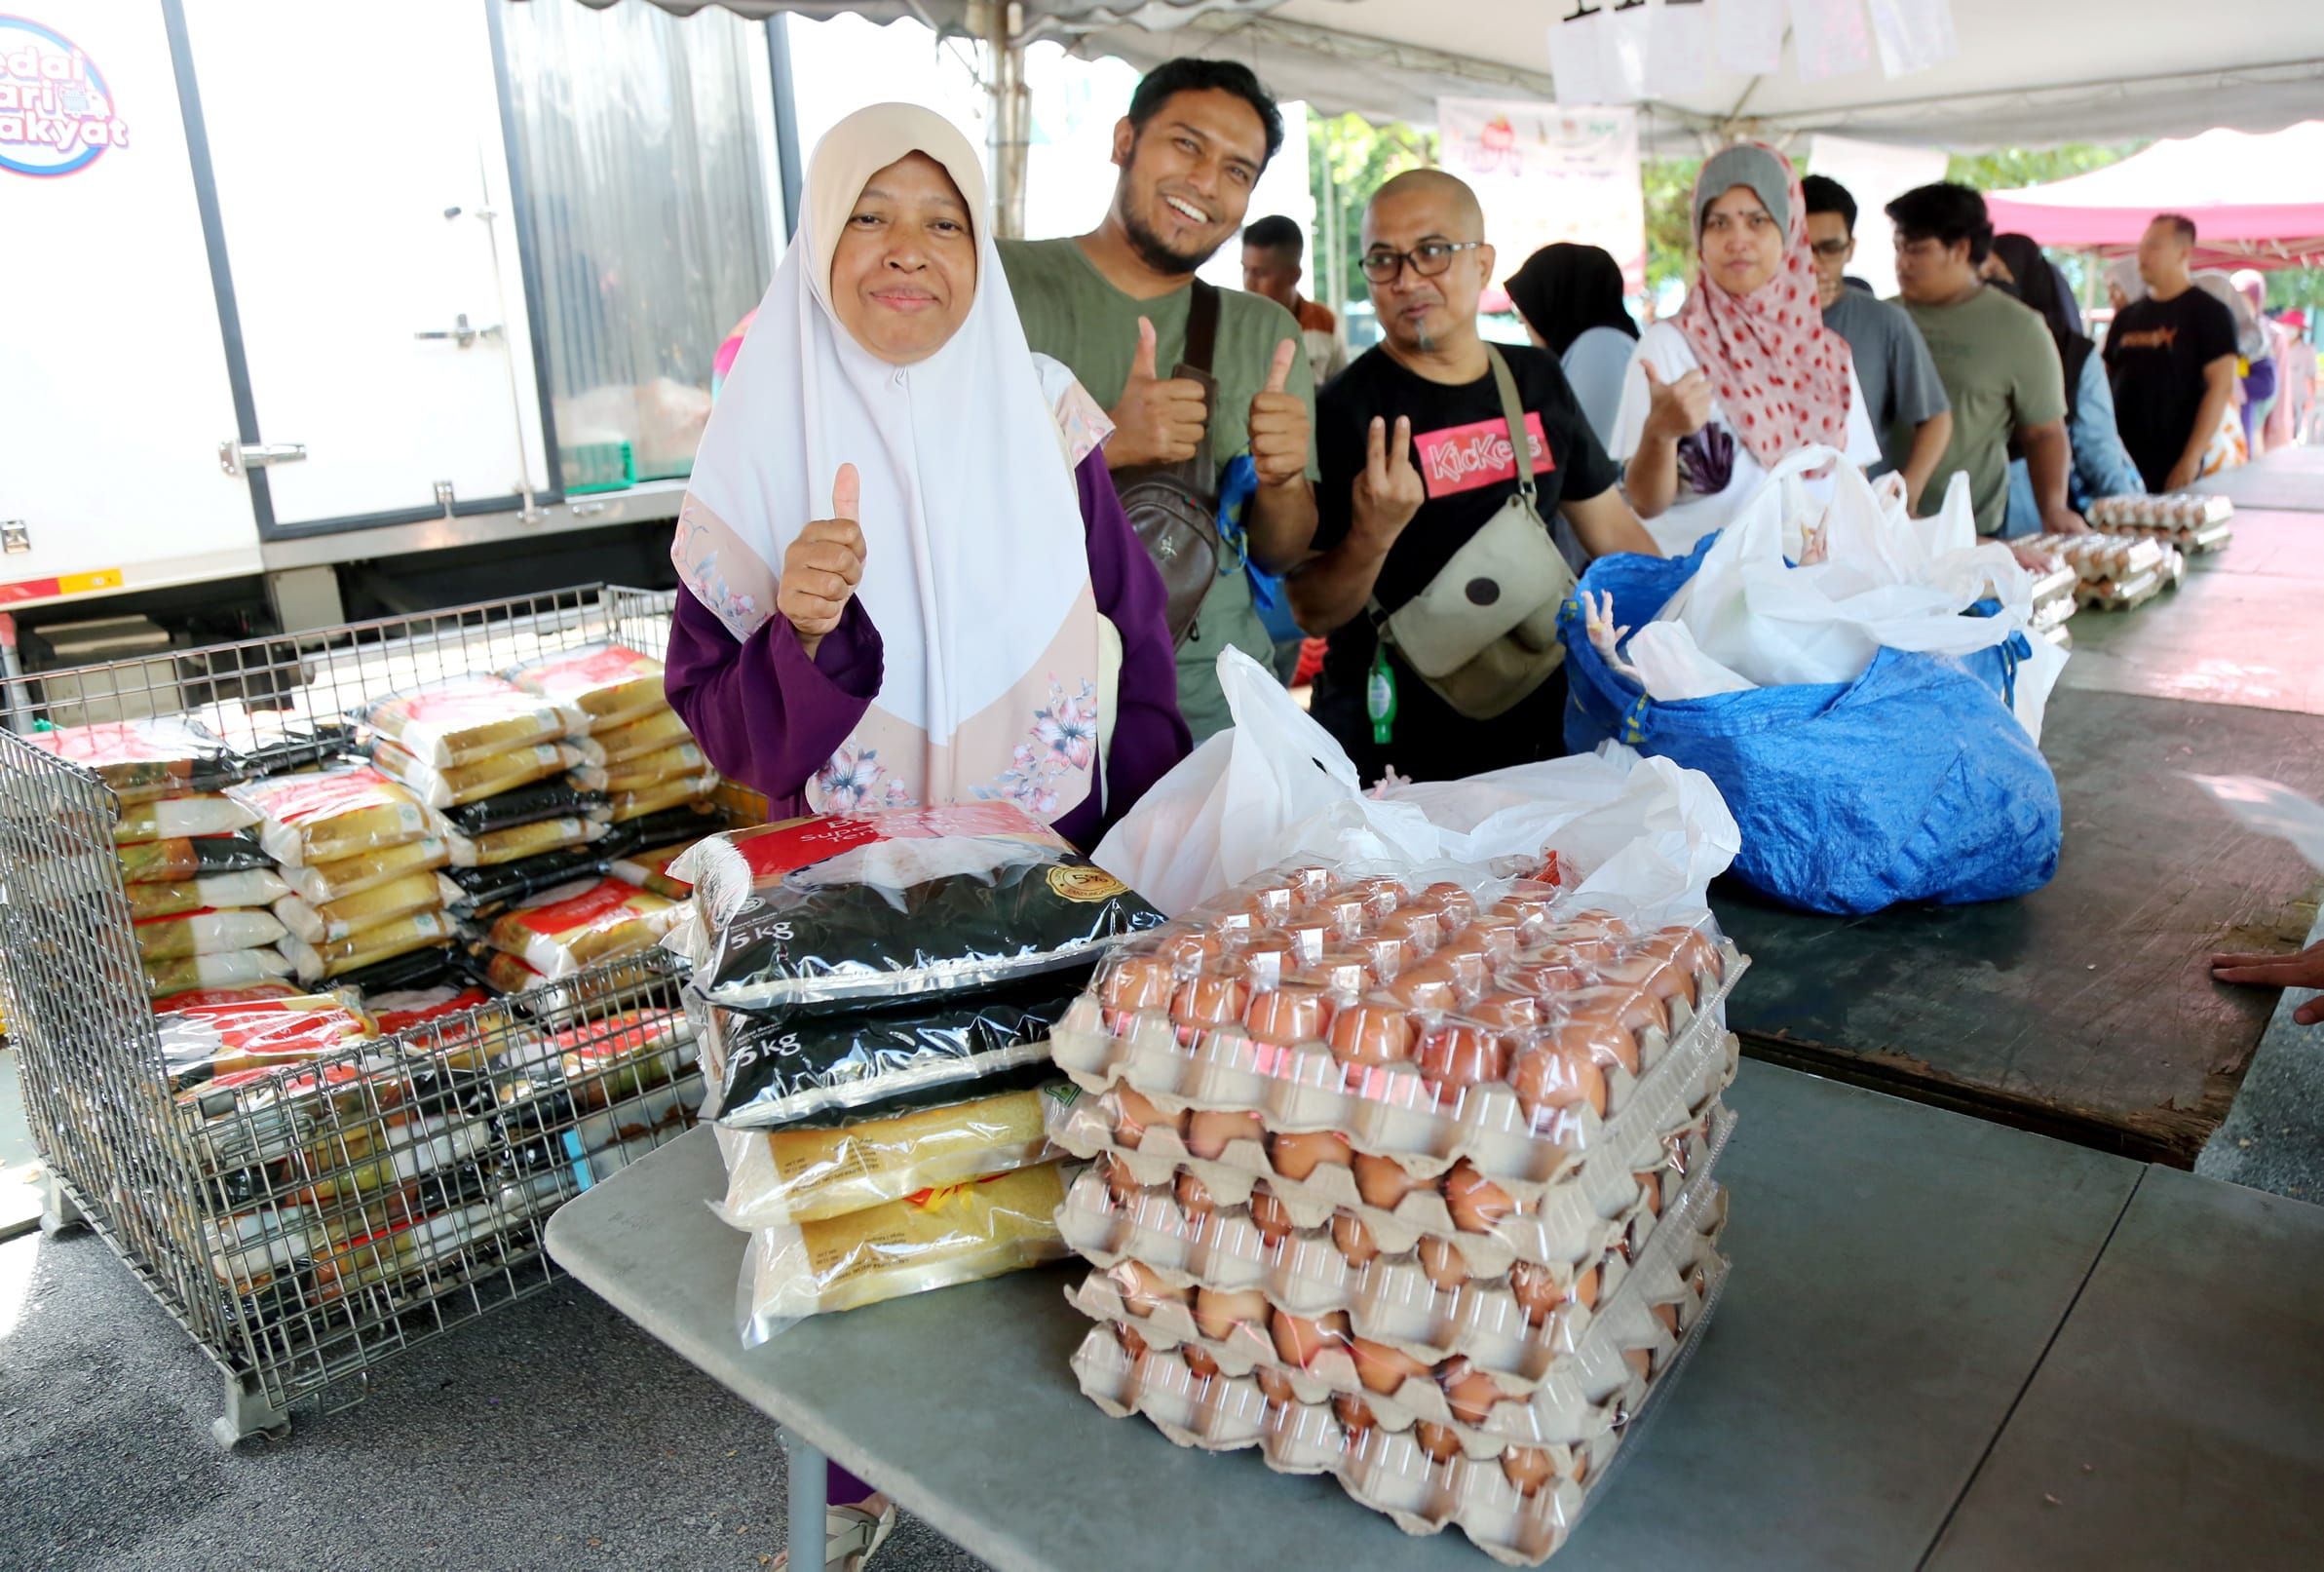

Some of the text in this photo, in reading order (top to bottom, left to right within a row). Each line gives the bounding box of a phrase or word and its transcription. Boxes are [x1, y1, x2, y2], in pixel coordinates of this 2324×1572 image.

[0, 79, 56, 114] ari
[0, 110, 129, 153] akyat
[1428, 433, 1543, 482] KicKes
[731, 932, 750, 951] 5
[754, 921, 794, 940] kg
[760, 1032, 801, 1057] kg
